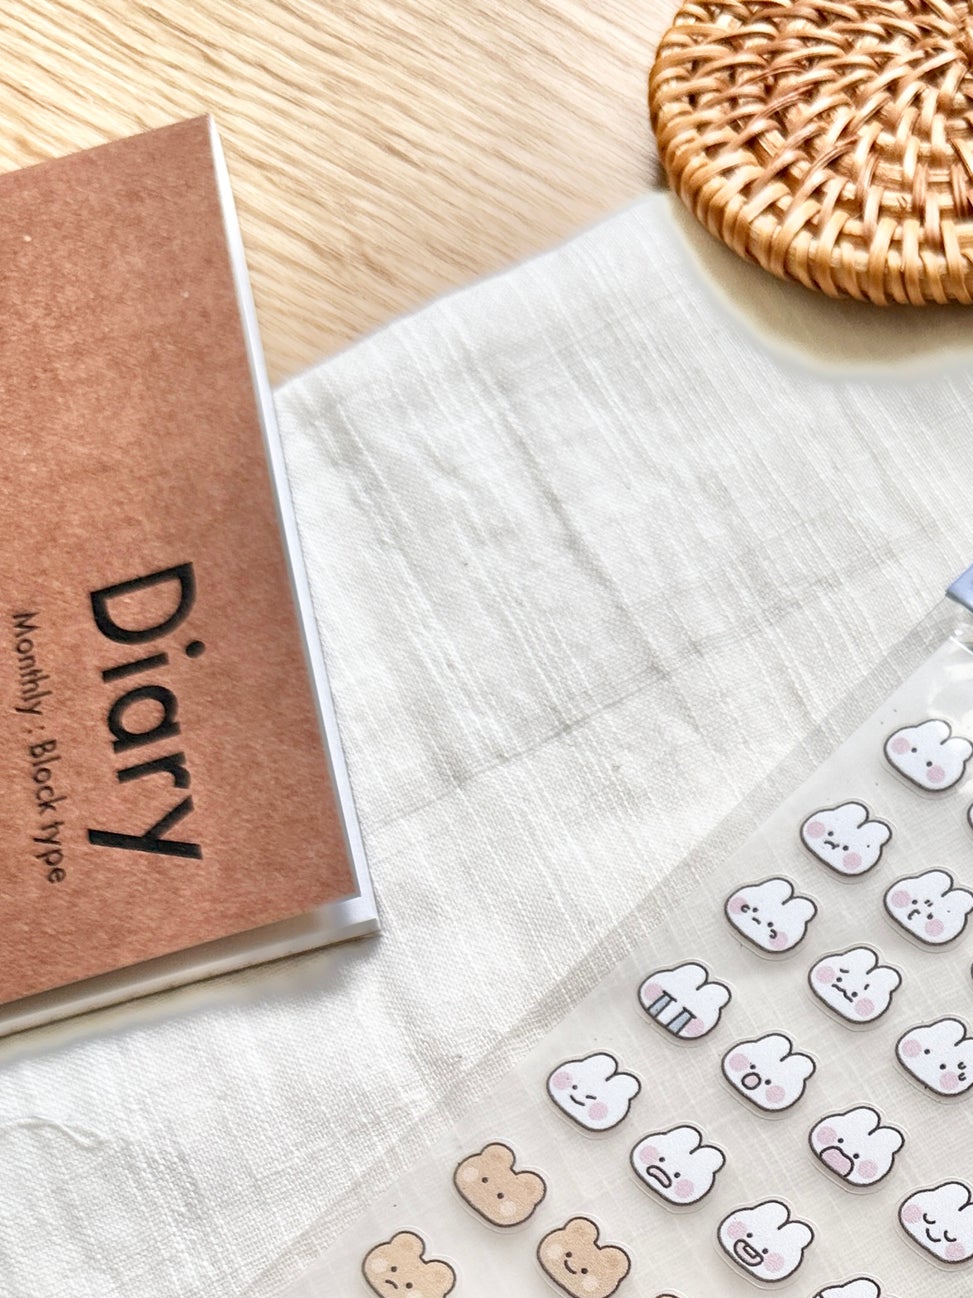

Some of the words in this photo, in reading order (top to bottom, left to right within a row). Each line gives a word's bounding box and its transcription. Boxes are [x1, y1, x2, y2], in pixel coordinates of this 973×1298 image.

[12, 610, 53, 717] Monthly
[88, 561, 206, 860] Diary
[29, 739, 69, 816] Block
[33, 818, 67, 885] type
